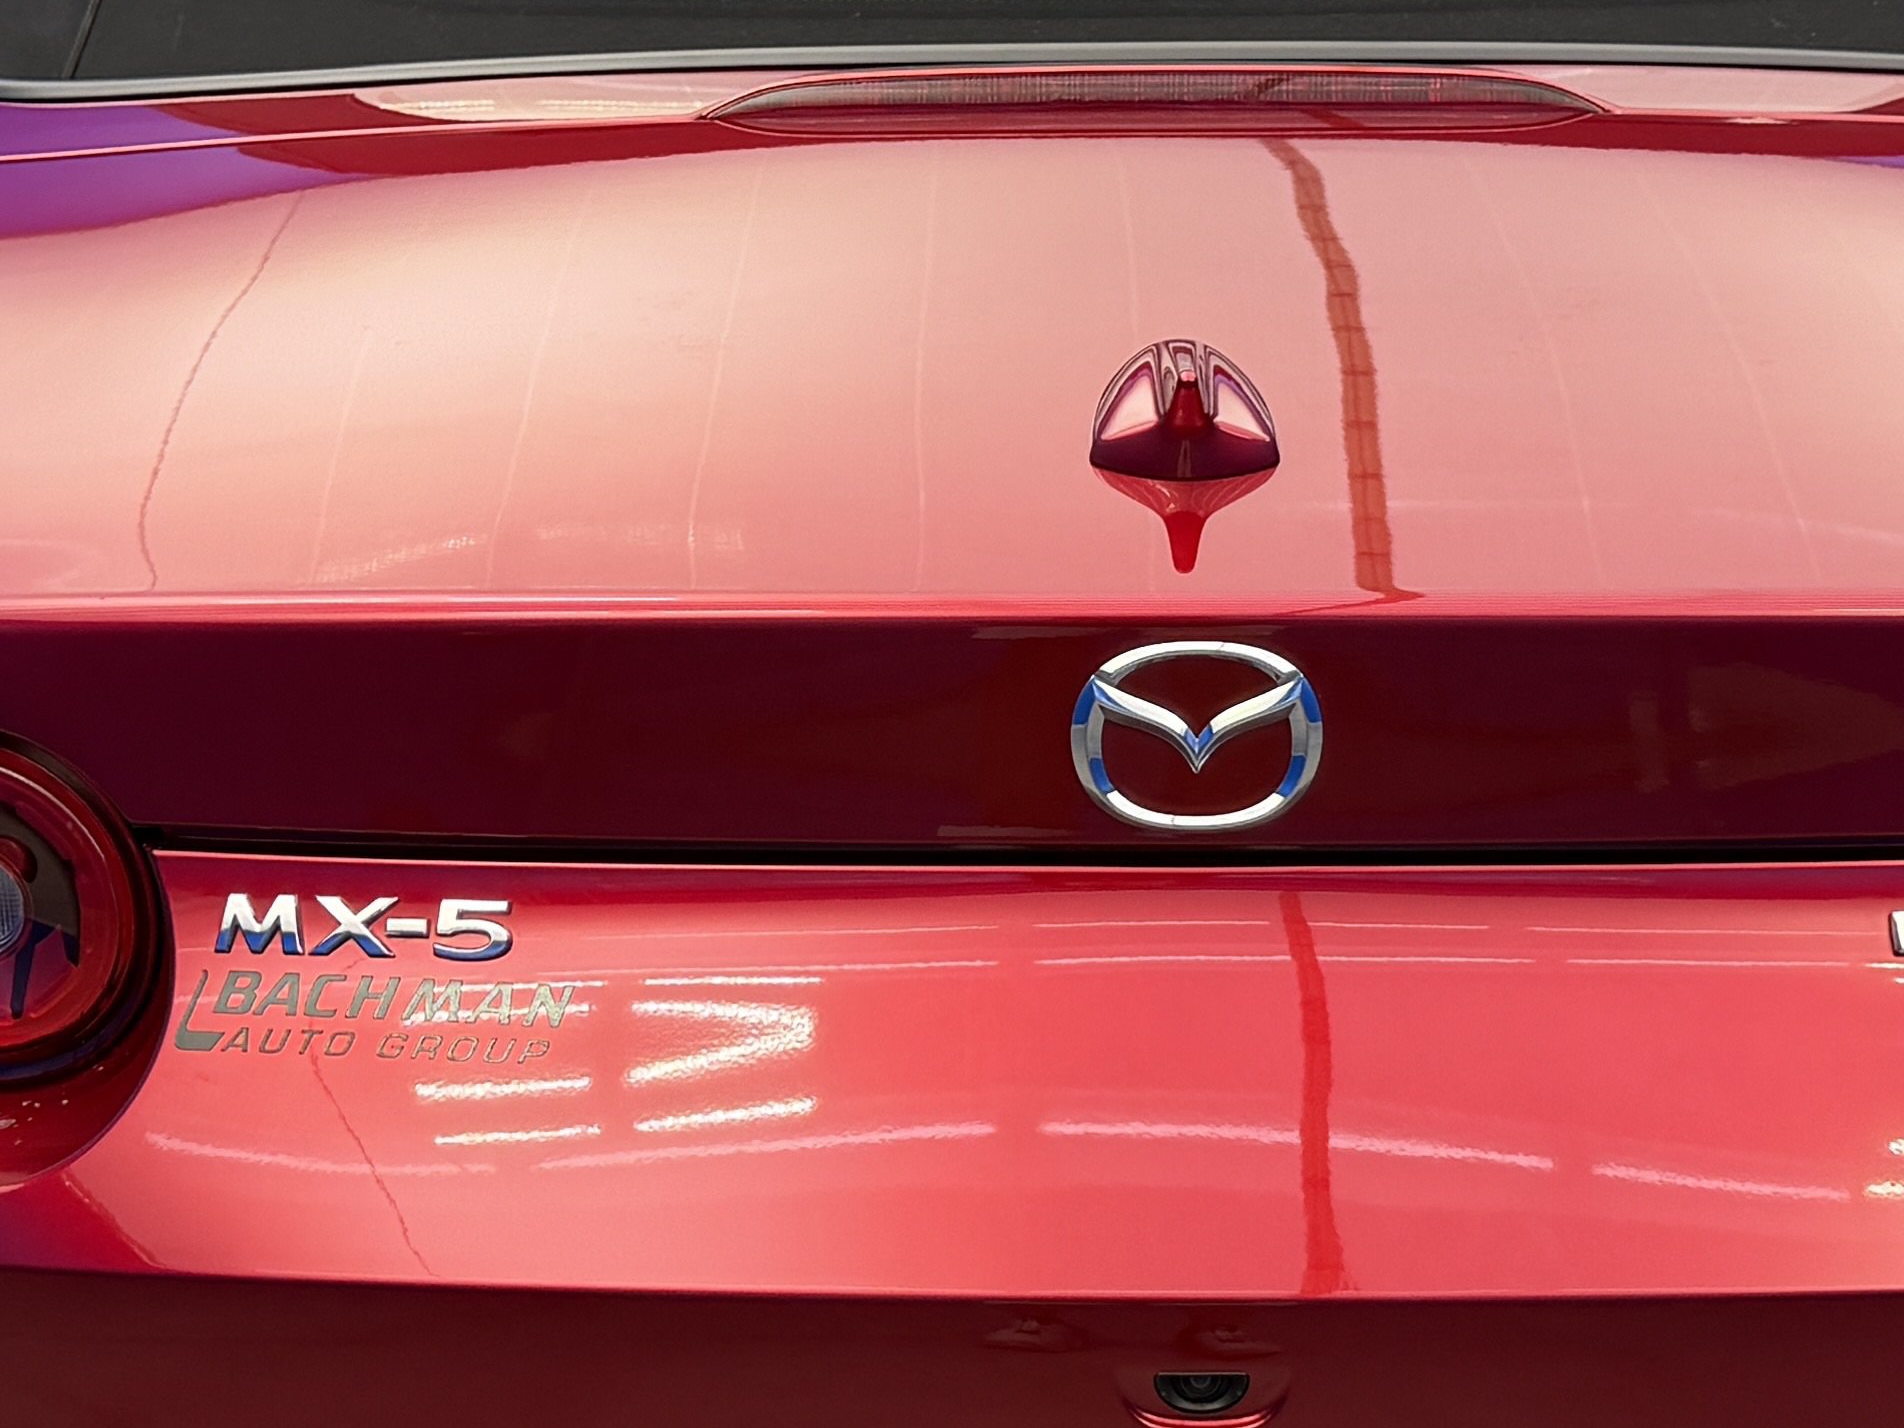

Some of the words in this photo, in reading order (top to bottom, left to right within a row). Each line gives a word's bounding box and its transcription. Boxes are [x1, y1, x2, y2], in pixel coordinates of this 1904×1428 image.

[214, 891, 514, 962] MX-5
[212, 969, 577, 1029] BACHMAN
[220, 1026, 357, 1057] AUTO
[376, 1032, 551, 1065] GROUP
